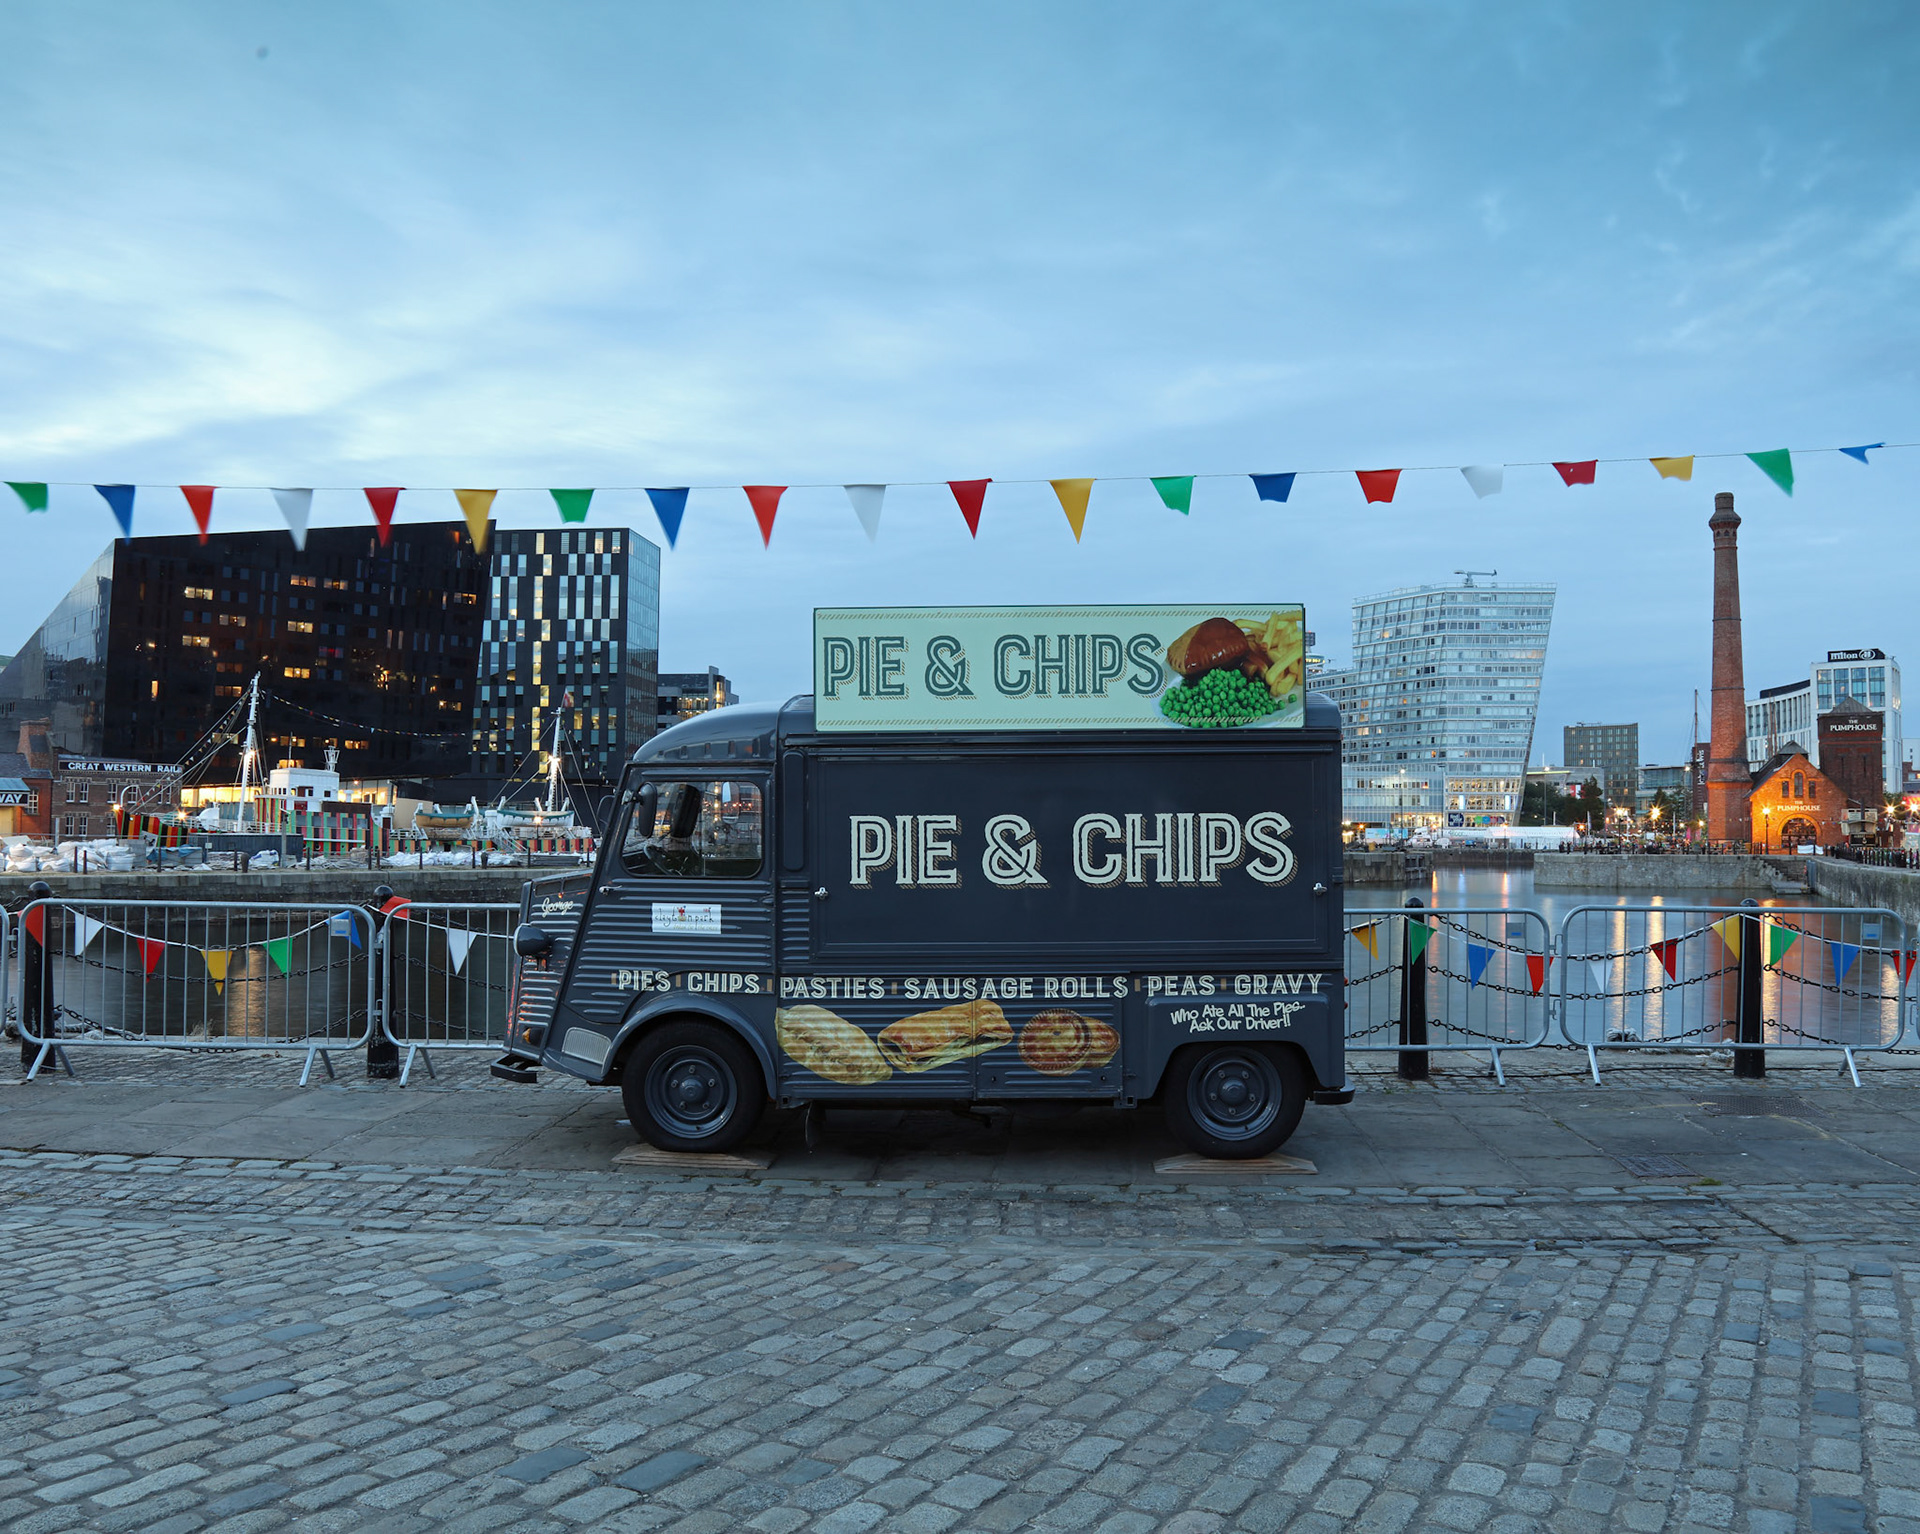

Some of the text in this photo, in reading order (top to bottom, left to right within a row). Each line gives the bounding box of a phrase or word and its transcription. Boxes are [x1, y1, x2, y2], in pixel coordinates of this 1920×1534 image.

[823, 633, 1166, 699] PIE & CHIPS
[68, 762, 100, 771] GREAT
[104, 763, 151, 772] WESTERN
[849, 811, 1298, 888] PIE & CHIPS
[541, 897, 574, 918] George
[618, 969, 1322, 1000] PIES CHIPS PASTIES SAUSAGE ROLLS PEAS GRAVY
[1170, 1008, 1199, 1025] Who
[1202, 1004, 1224, 1018] Ate
[1228, 1004, 1244, 1017] All
[1247, 1003, 1270, 1017] The
[1189, 1013, 1291, 1033] Ask Our Driver!!
